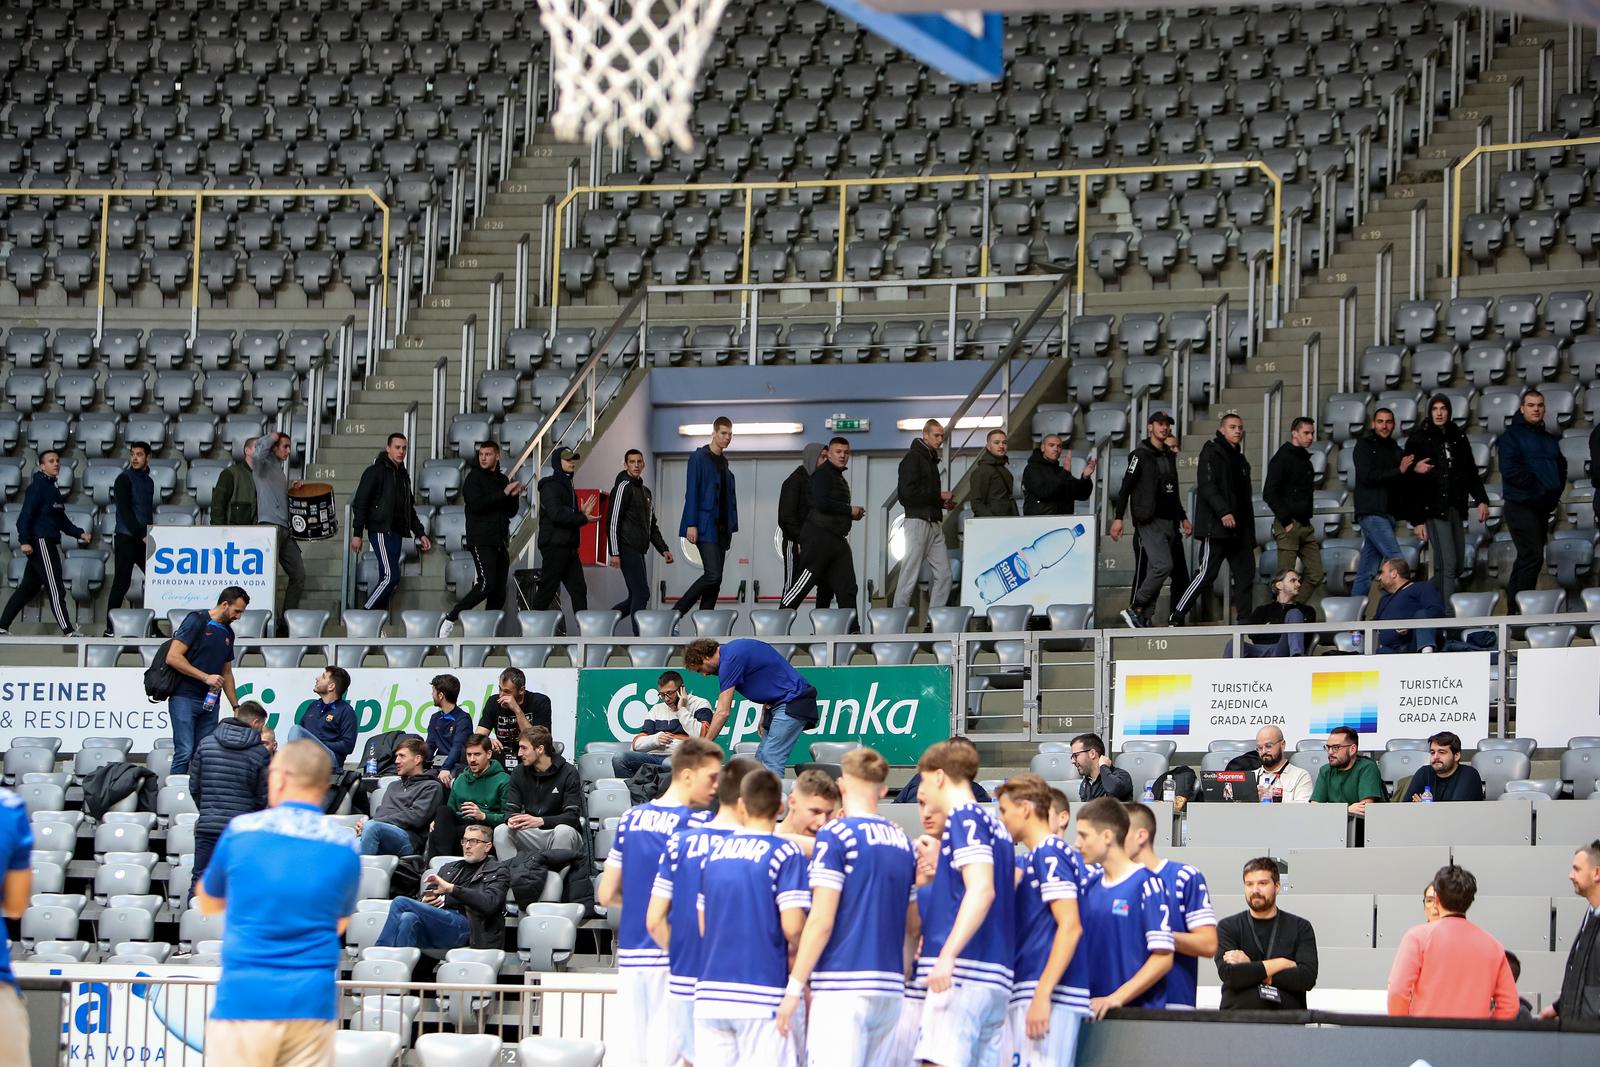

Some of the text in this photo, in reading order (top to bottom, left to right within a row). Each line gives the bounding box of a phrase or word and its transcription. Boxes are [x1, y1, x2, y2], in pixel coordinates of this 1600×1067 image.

[154, 542, 264, 575] santa
[152, 578, 195, 586] PRIRODNA
[1000, 561, 1019, 589] santa
[1, 682, 107, 702] STEINER
[1211, 680, 1273, 693] TURISTIČKA
[1400, 676, 1463, 690] TURISTIČKA
[1210, 699, 1268, 710] ZAJEDNICA
[1399, 696, 1458, 708] ZAJEDNICA
[0, 710, 169, 729] & RESIDENCES
[1210, 715, 1286, 725] GRADA ZADRA
[1398, 712, 1477, 723] GRADA ZADRA
[629, 809, 680, 836] ZADAR
[963, 819, 981, 846] 2
[710, 836, 771, 863] ZADAR
[1045, 856, 1061, 882] 2
[1159, 903, 1172, 931] 2
[70, 1044, 166, 1061] KA VODA
